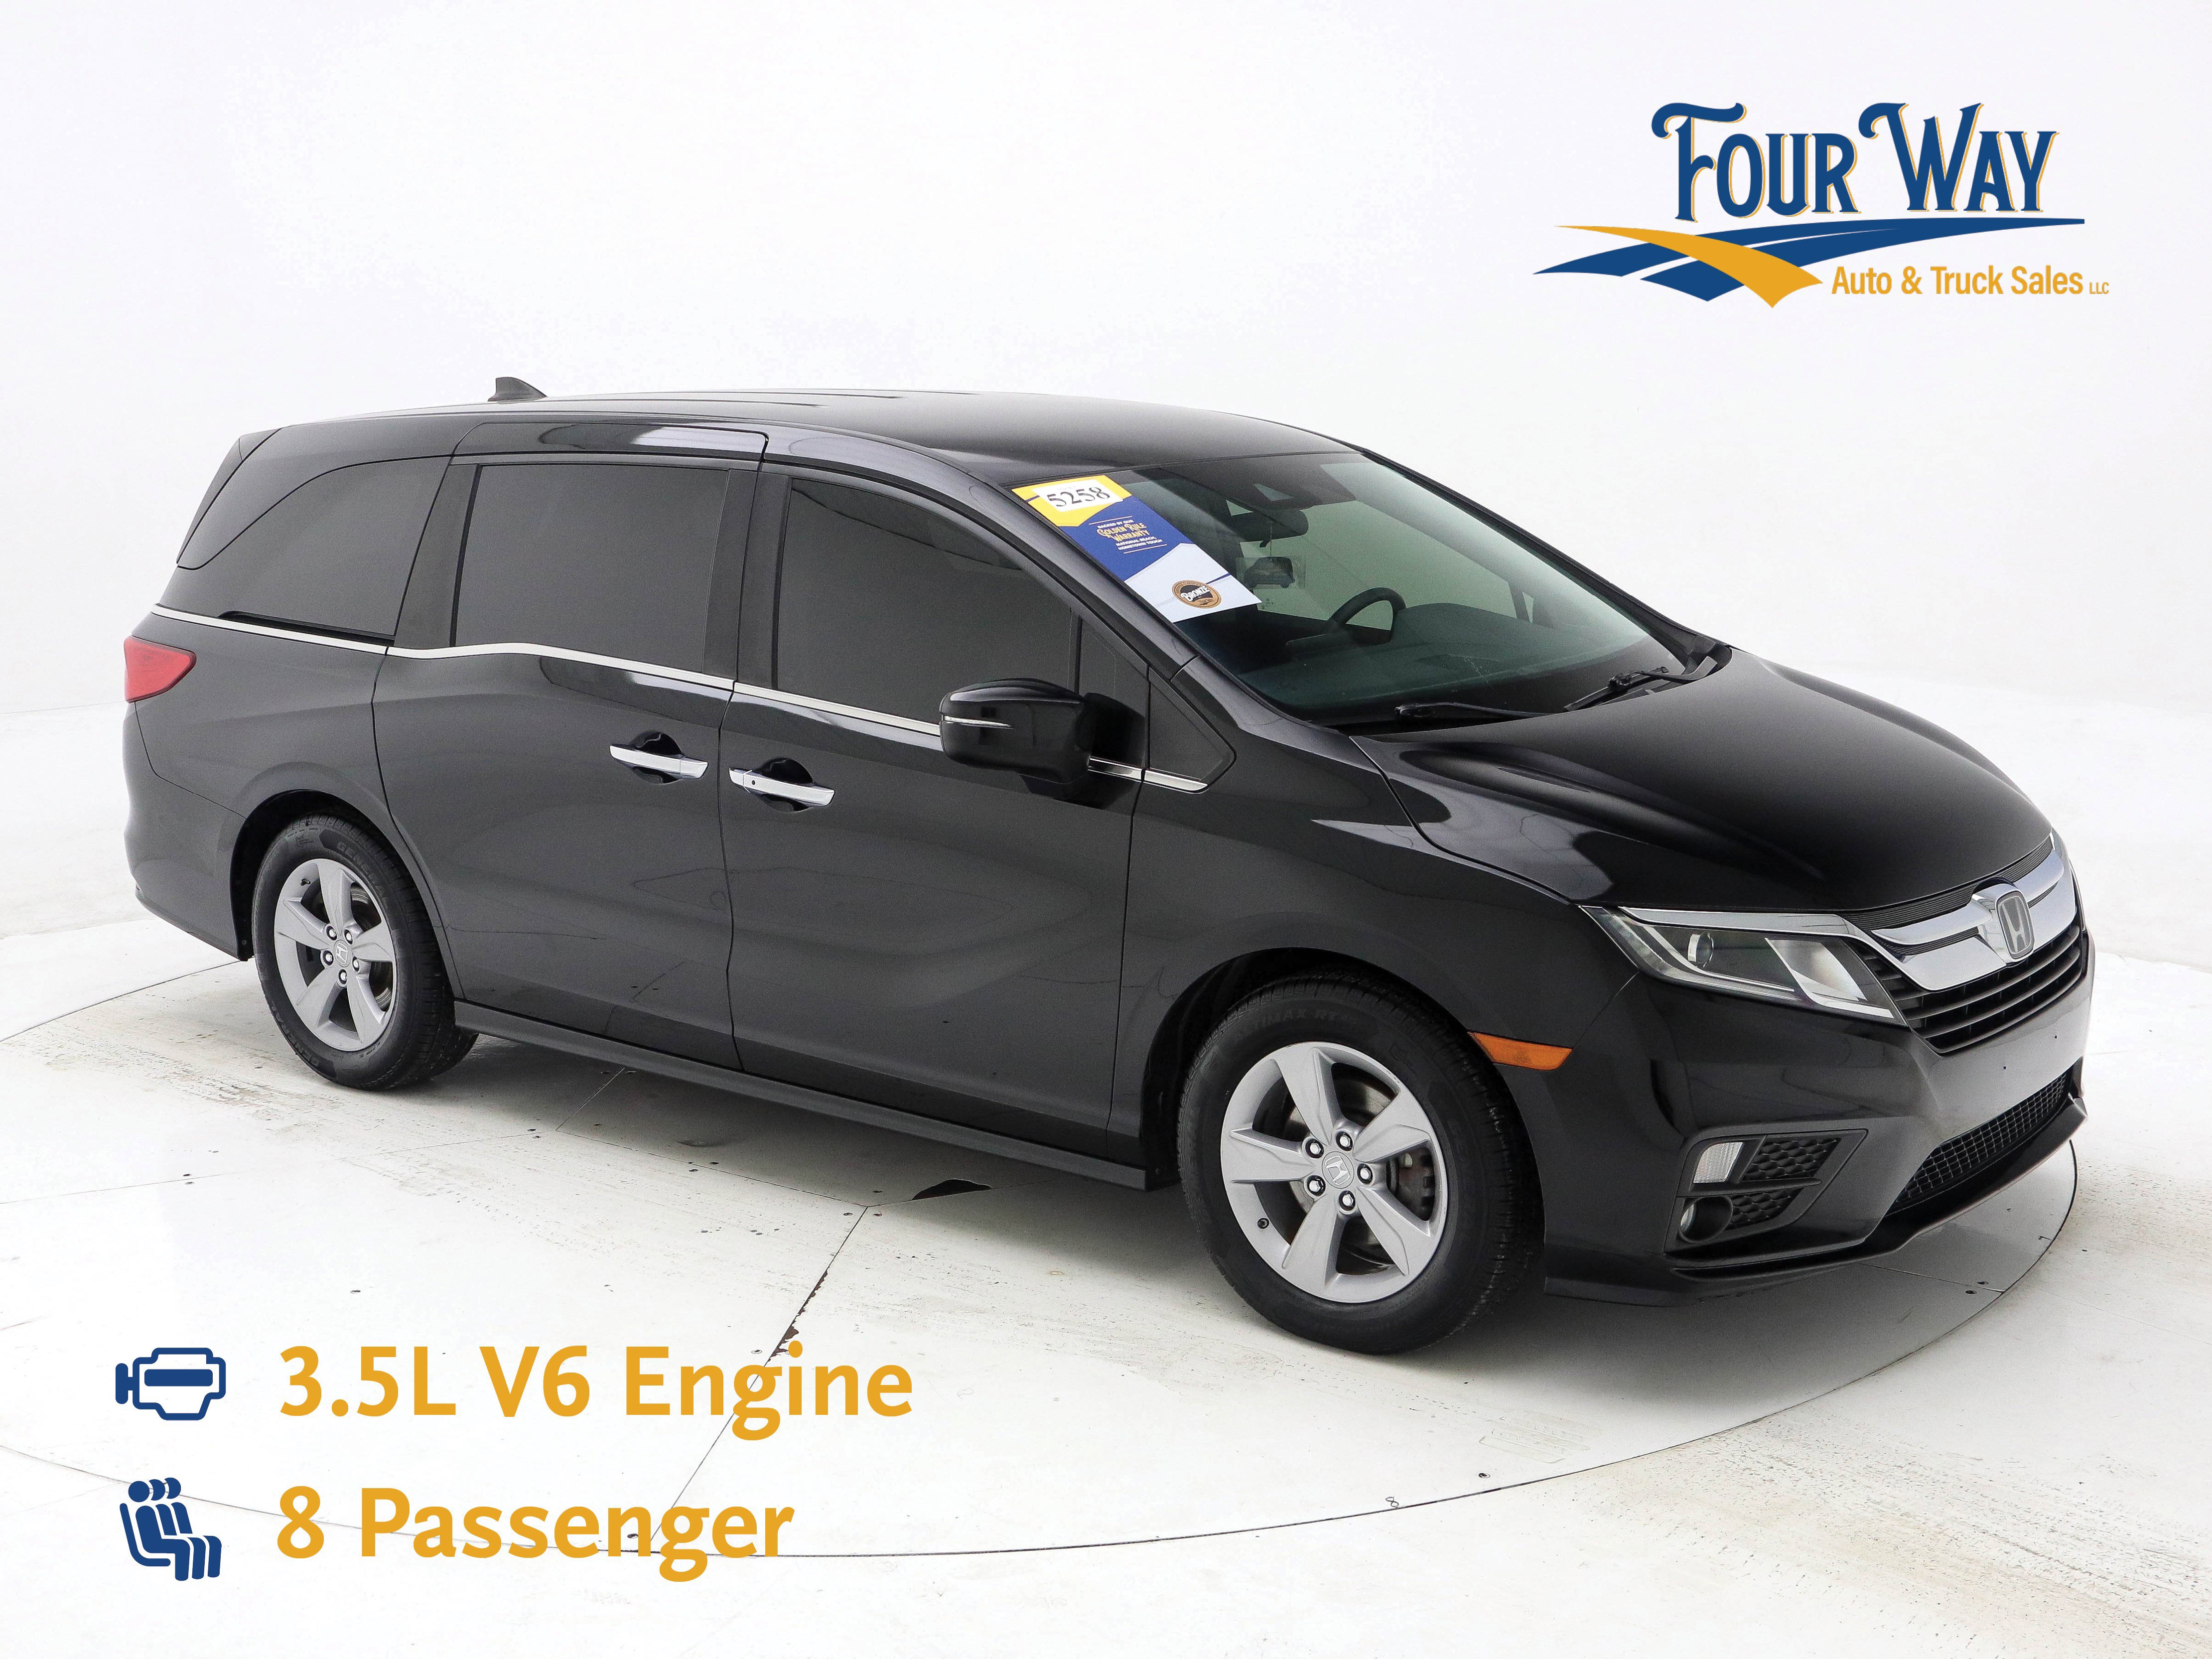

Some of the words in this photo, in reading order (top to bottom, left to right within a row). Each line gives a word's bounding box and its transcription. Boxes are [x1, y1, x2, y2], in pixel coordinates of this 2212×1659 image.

[1047, 487, 1110, 507] 5258
[1097, 526, 1127, 537] GOLDEN
[1124, 523, 1147, 532] RULE
[1107, 530, 1150, 542] WARRANTY
[1180, 585, 1211, 602] BRONZE
[337, 840, 389, 909] GENERAL
